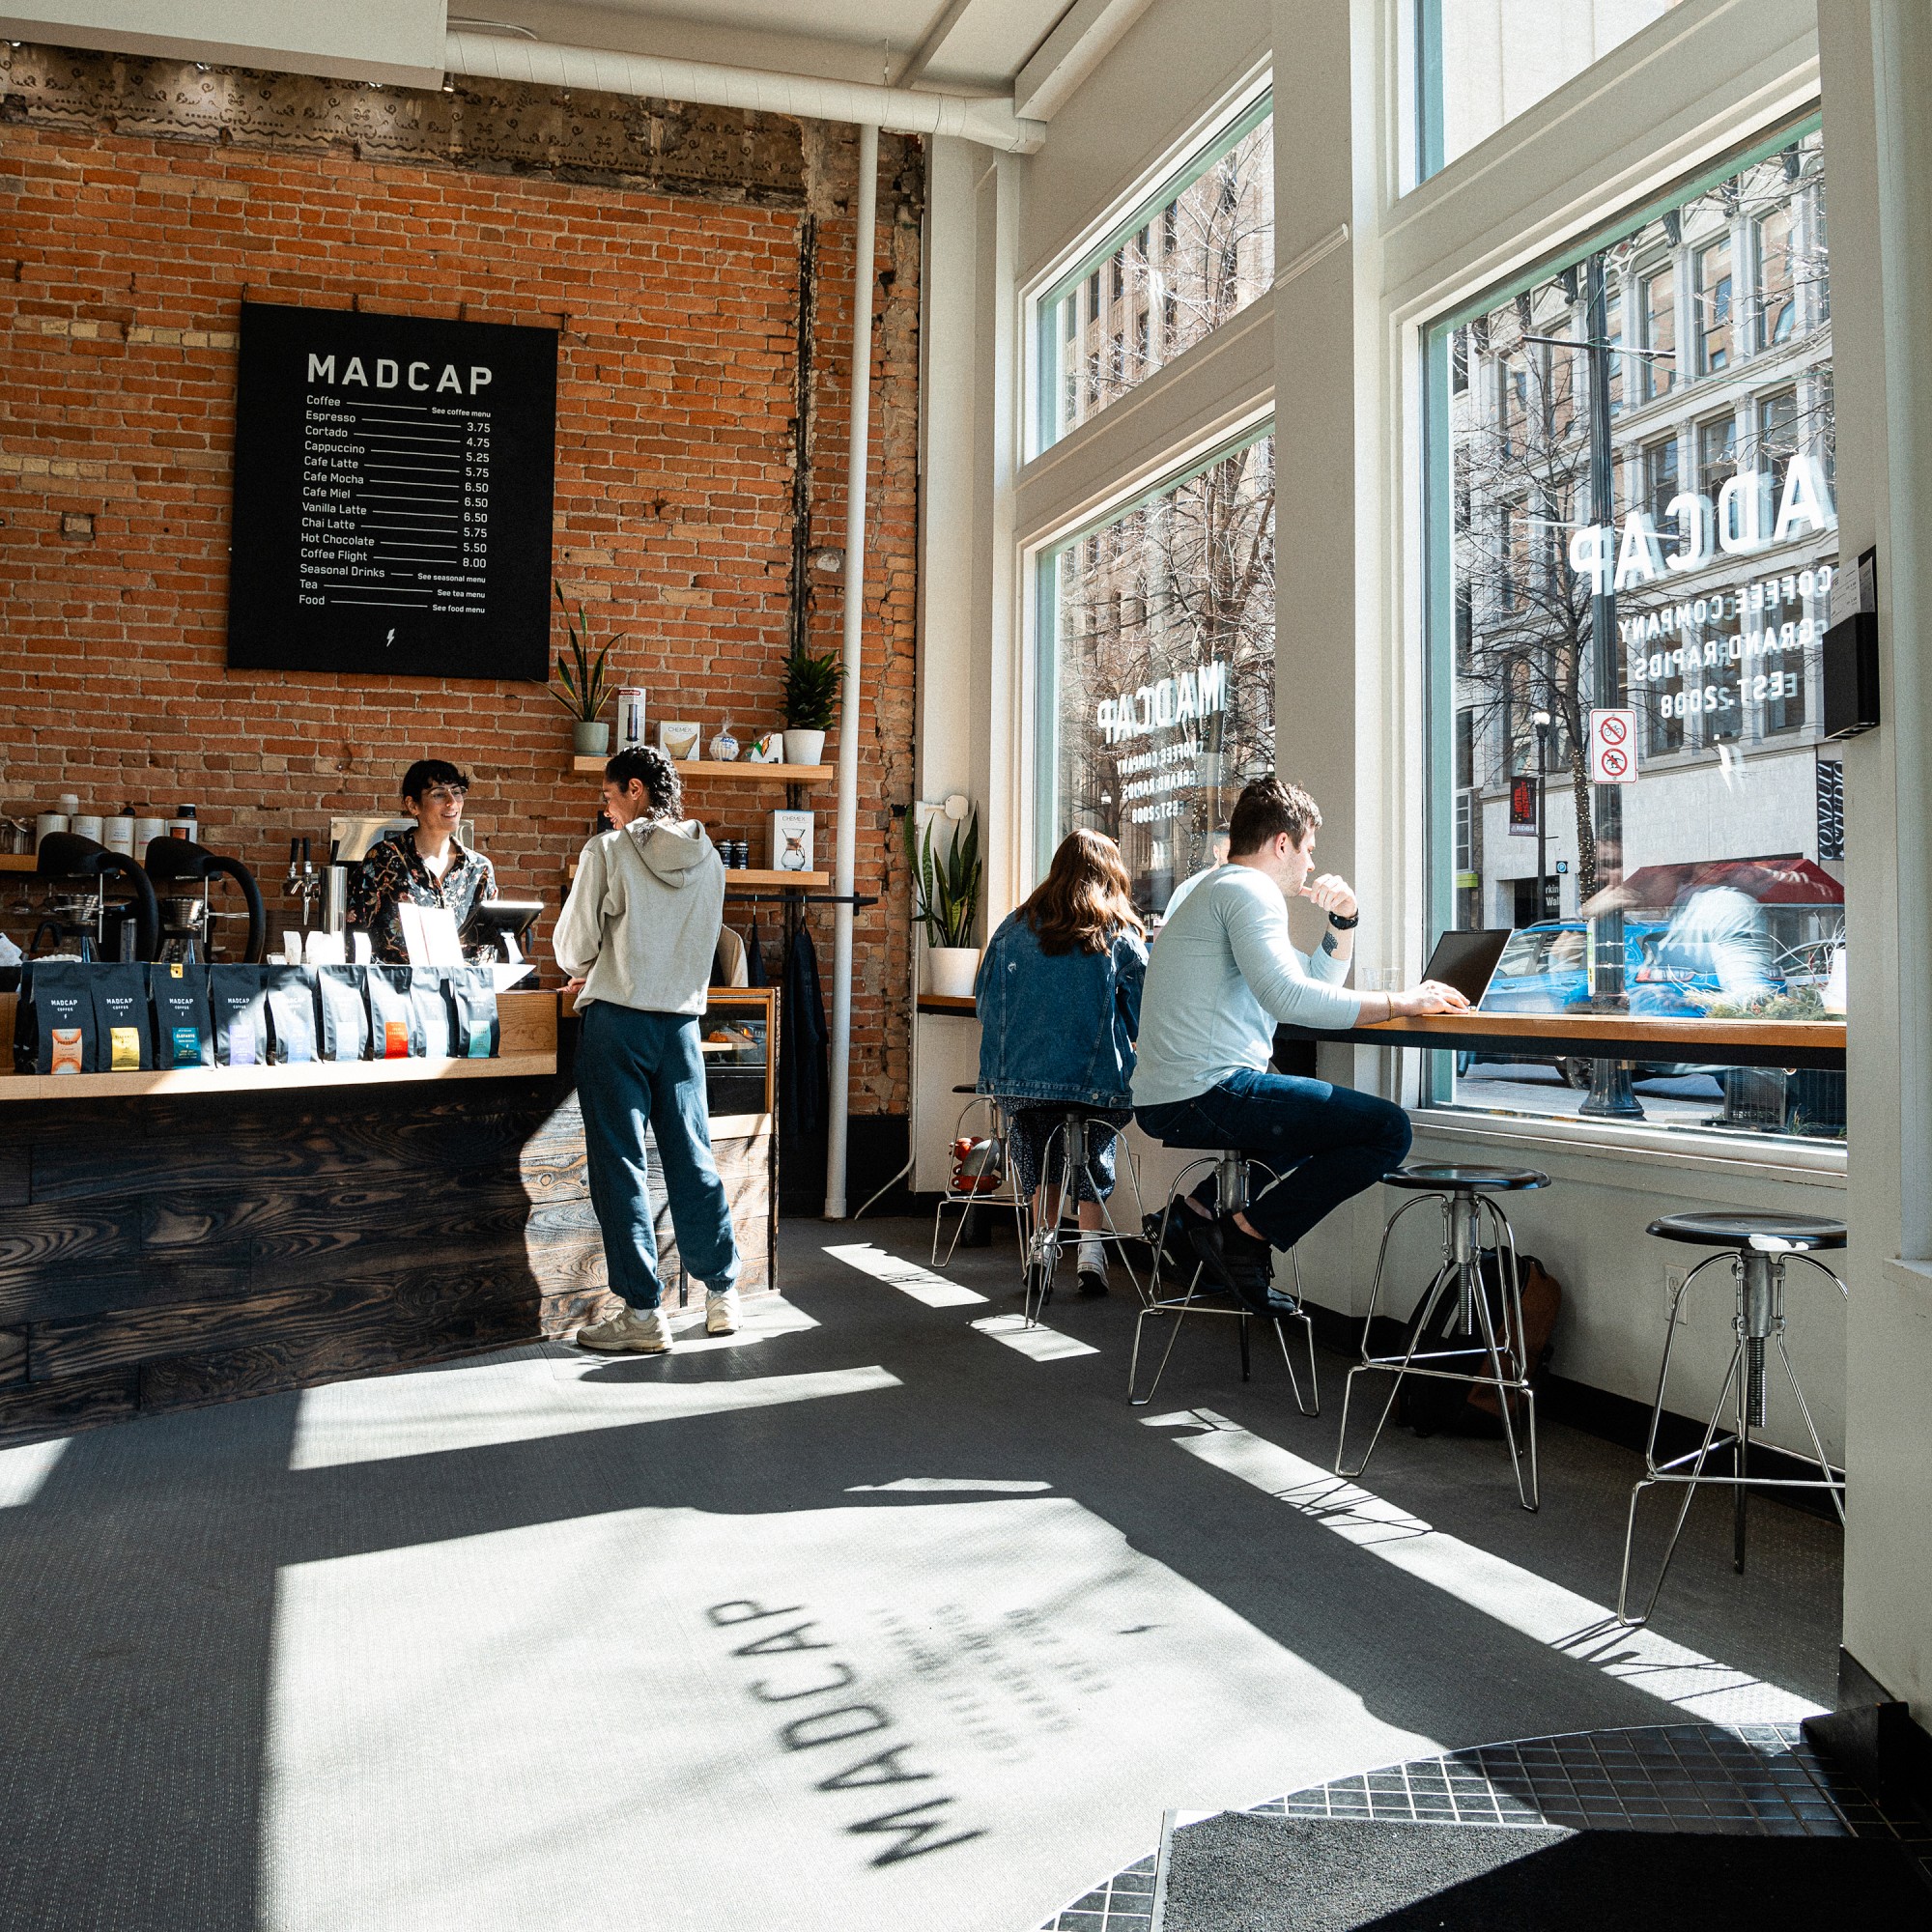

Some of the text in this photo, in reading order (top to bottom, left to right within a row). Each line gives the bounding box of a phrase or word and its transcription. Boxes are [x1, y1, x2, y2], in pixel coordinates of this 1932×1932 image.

[308, 354, 492, 394] MADCAP
[307, 395, 340, 406] Coffee
[447, 408, 469, 416] coffee
[306, 411, 490, 433] Espresso 3.75
[306, 426, 490, 447] Cortado 4.75
[305, 440, 489, 462] Cappuccino 5.25
[304, 456, 489, 477] Cafe Latte 5.75
[304, 471, 488, 493] Cafe Mocha 6.50
[303, 487, 488, 507] Cafe Miel 6.50
[302, 502, 487, 523] Vanilla Latte 6.50
[302, 518, 487, 537] Chai Latte 5.75
[301, 533, 486, 553] Hot Chocolate 5.50
[301, 549, 486, 568] Coffee Flight 8.00
[300, 564, 348, 575] Seasonal
[352, 566, 384, 577] Drinks
[300, 580, 317, 588] Tea
[299, 595, 325, 605] Food
[448, 604, 464, 612] food
[1515, 787, 1523, 812] HOTEL
[1817, 762, 1834, 860] CONDUIT
[705, 1600, 992, 1868] MADCAP
